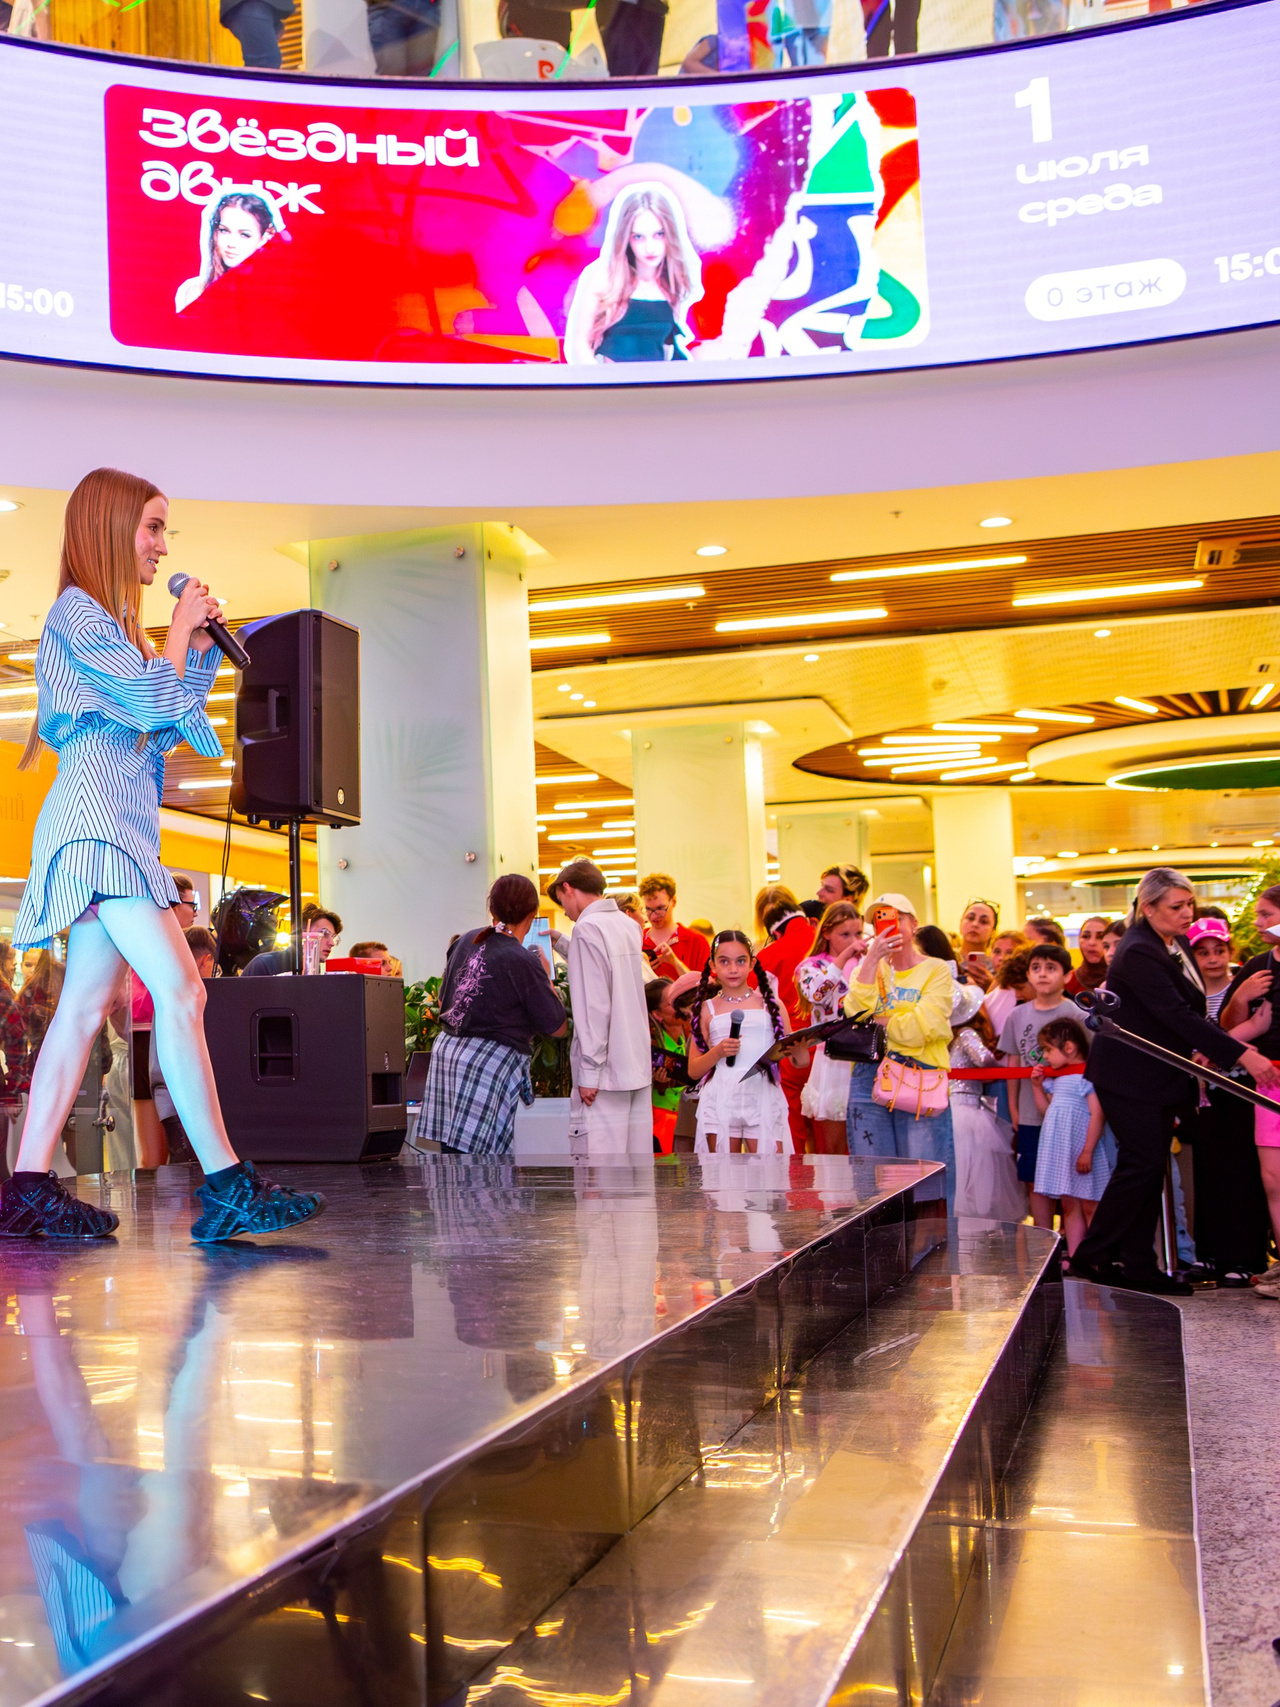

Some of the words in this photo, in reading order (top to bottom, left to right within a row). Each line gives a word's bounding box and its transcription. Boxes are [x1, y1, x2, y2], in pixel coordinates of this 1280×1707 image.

[1015, 76, 1052, 143] 1
[1016, 145, 1149, 184] июля
[140, 160, 325, 214] двж
[1018, 183, 1163, 227] среда
[1047, 287, 1063, 307] 0
[1075, 276, 1163, 304] этаж
